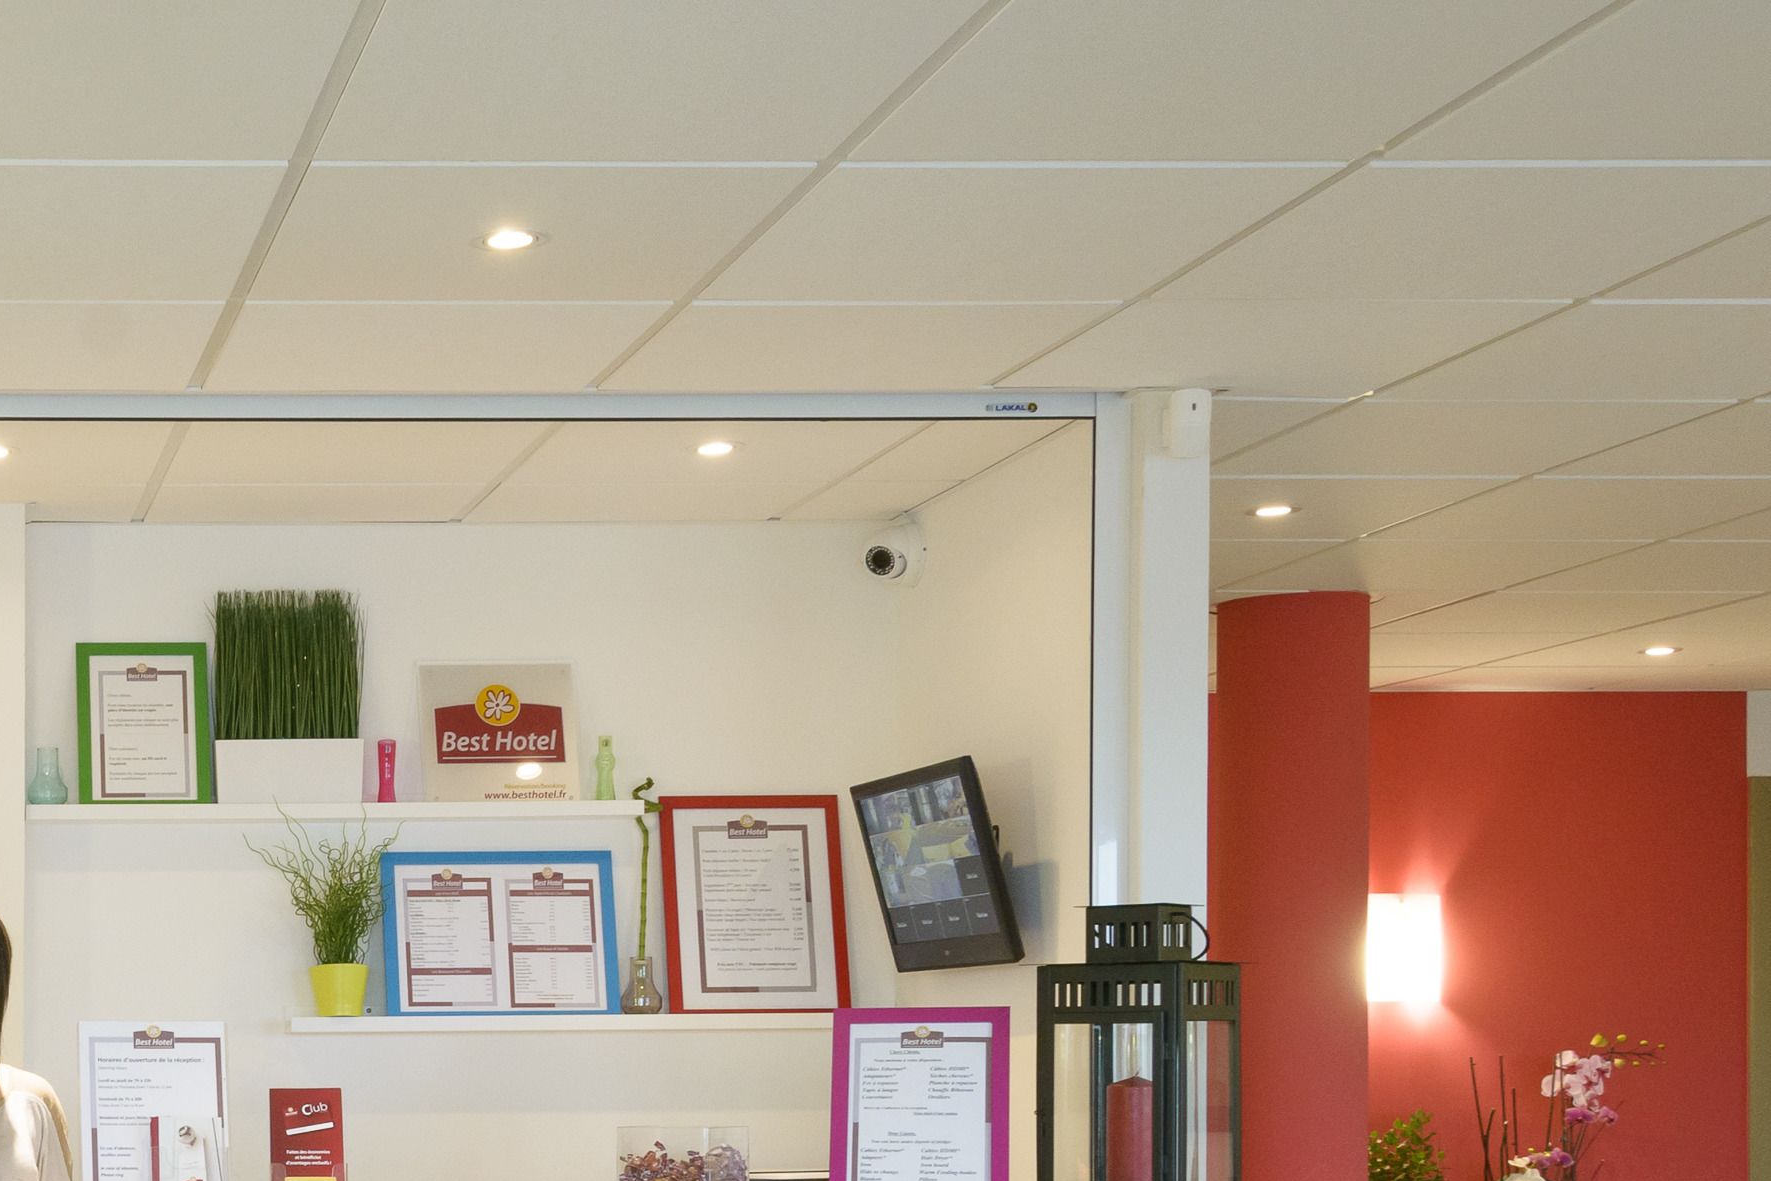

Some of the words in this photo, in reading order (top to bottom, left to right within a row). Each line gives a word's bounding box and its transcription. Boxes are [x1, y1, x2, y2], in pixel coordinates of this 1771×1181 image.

[442, 731, 491, 752] Best
[495, 729, 557, 752] Hotel
[484, 790, 567, 801] www.besthotel.fr
[729, 828, 745, 836] Best
[746, 828, 767, 836] Hotel
[135, 1038, 151, 1047] Best
[151, 1038, 173, 1047] Hotel
[902, 1038, 920, 1046] Best
[920, 1037, 943, 1046] Hotel
[301, 1102, 328, 1116] Club
